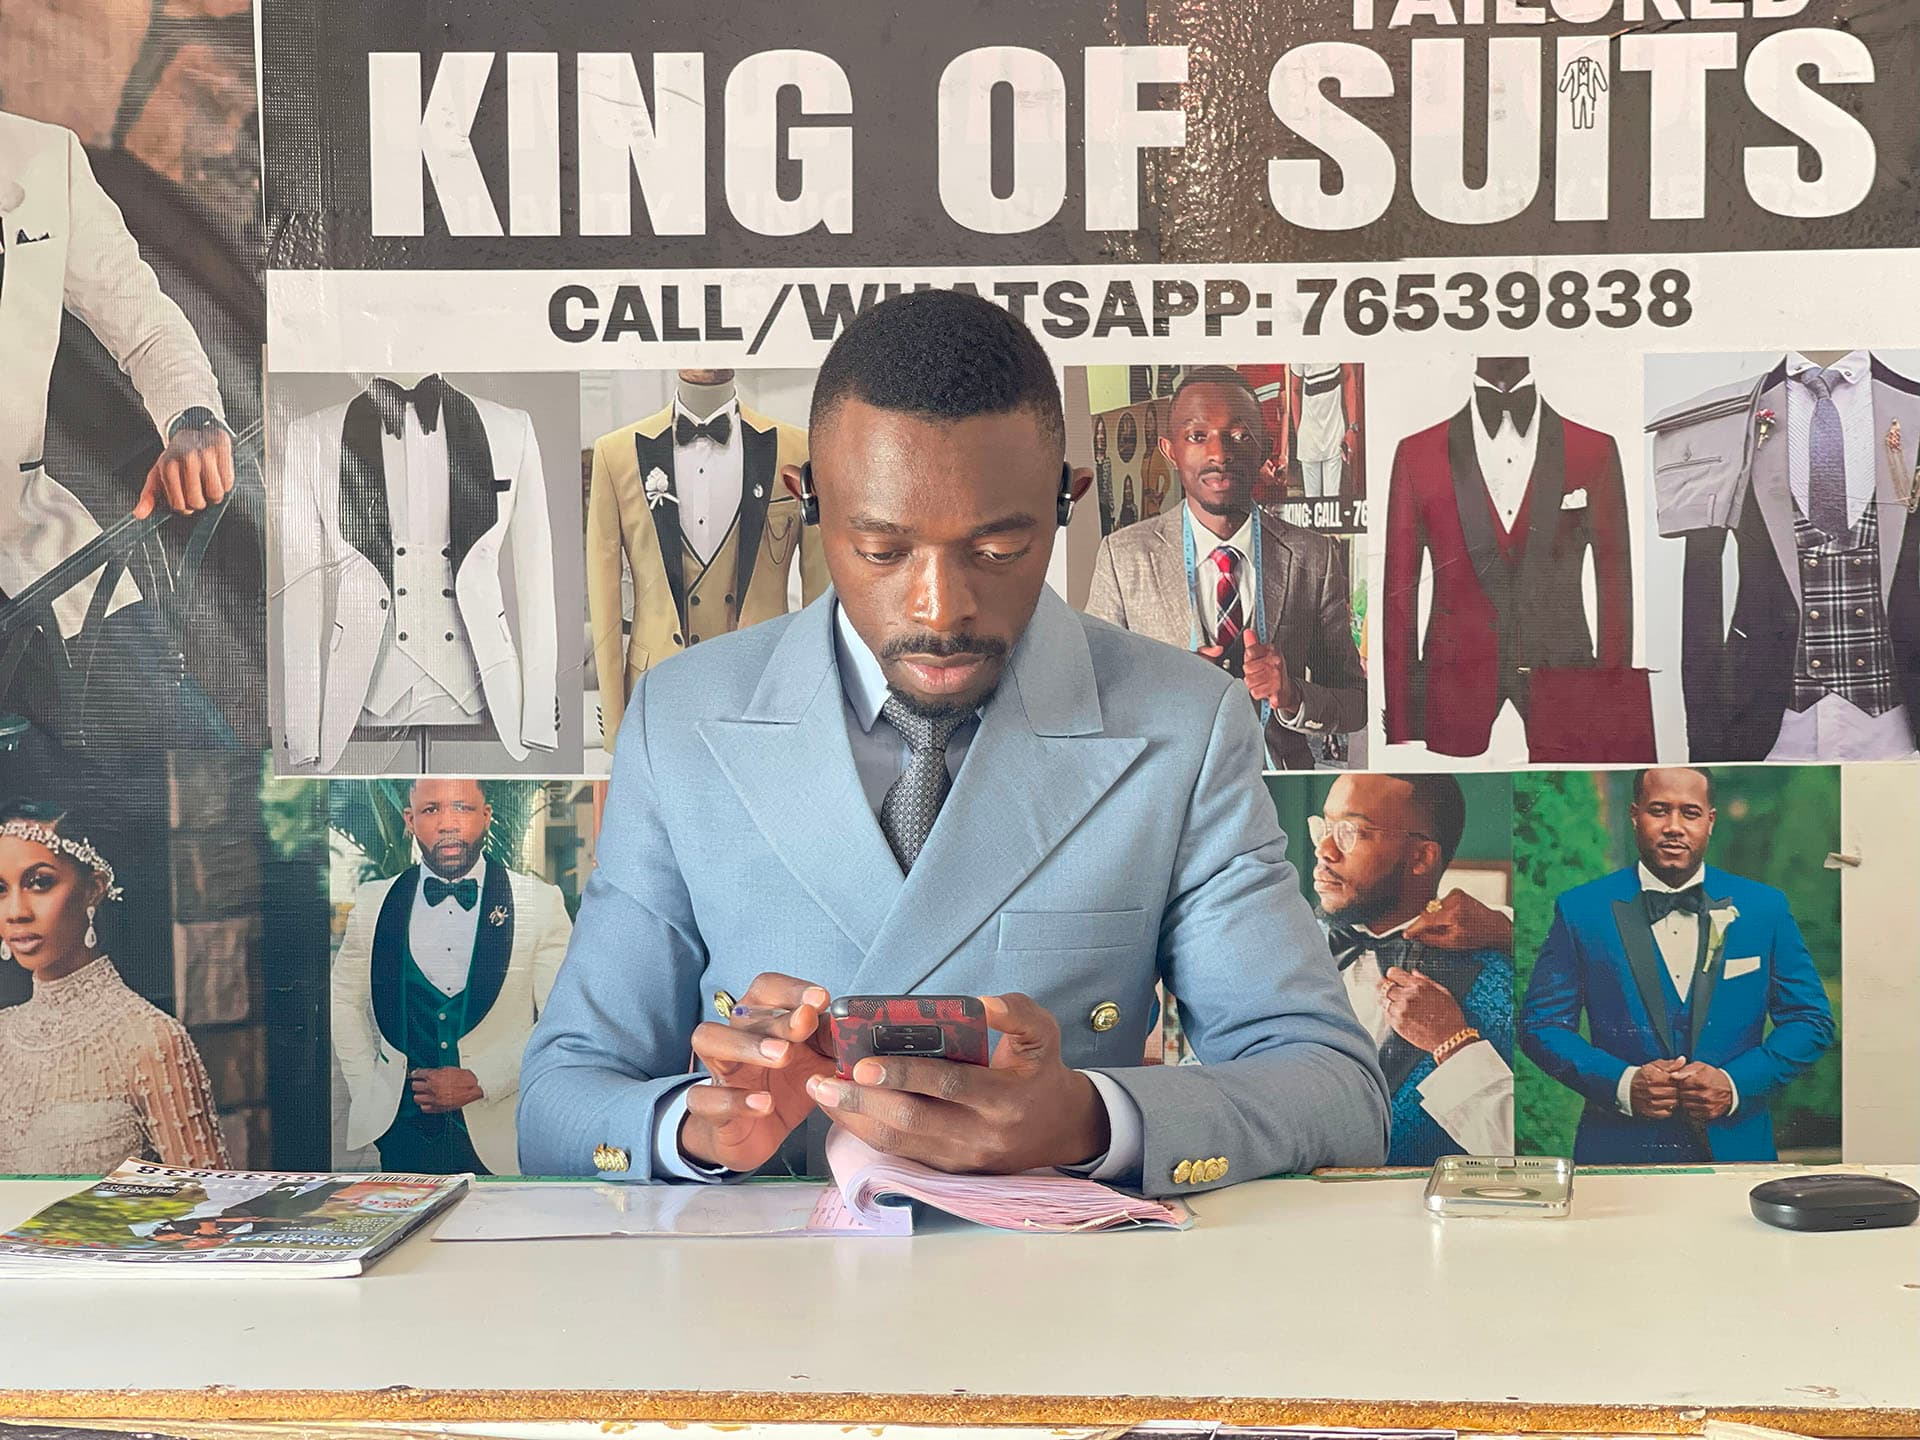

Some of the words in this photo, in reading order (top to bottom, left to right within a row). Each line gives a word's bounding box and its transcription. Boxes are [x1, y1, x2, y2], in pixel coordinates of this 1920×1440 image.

[368, 49, 853, 237] KING
[938, 43, 1189, 234] OF
[1268, 28, 1876, 230] SUITS
[548, 280, 1273, 355] CALL/WTSAPP:
[1297, 269, 1693, 336] 76539838
[1314, 501, 1343, 528] CALL
[136, 1165, 340, 1182] 76539838
[133, 1253, 208, 1261] OF
[214, 1252, 349, 1261] KING
